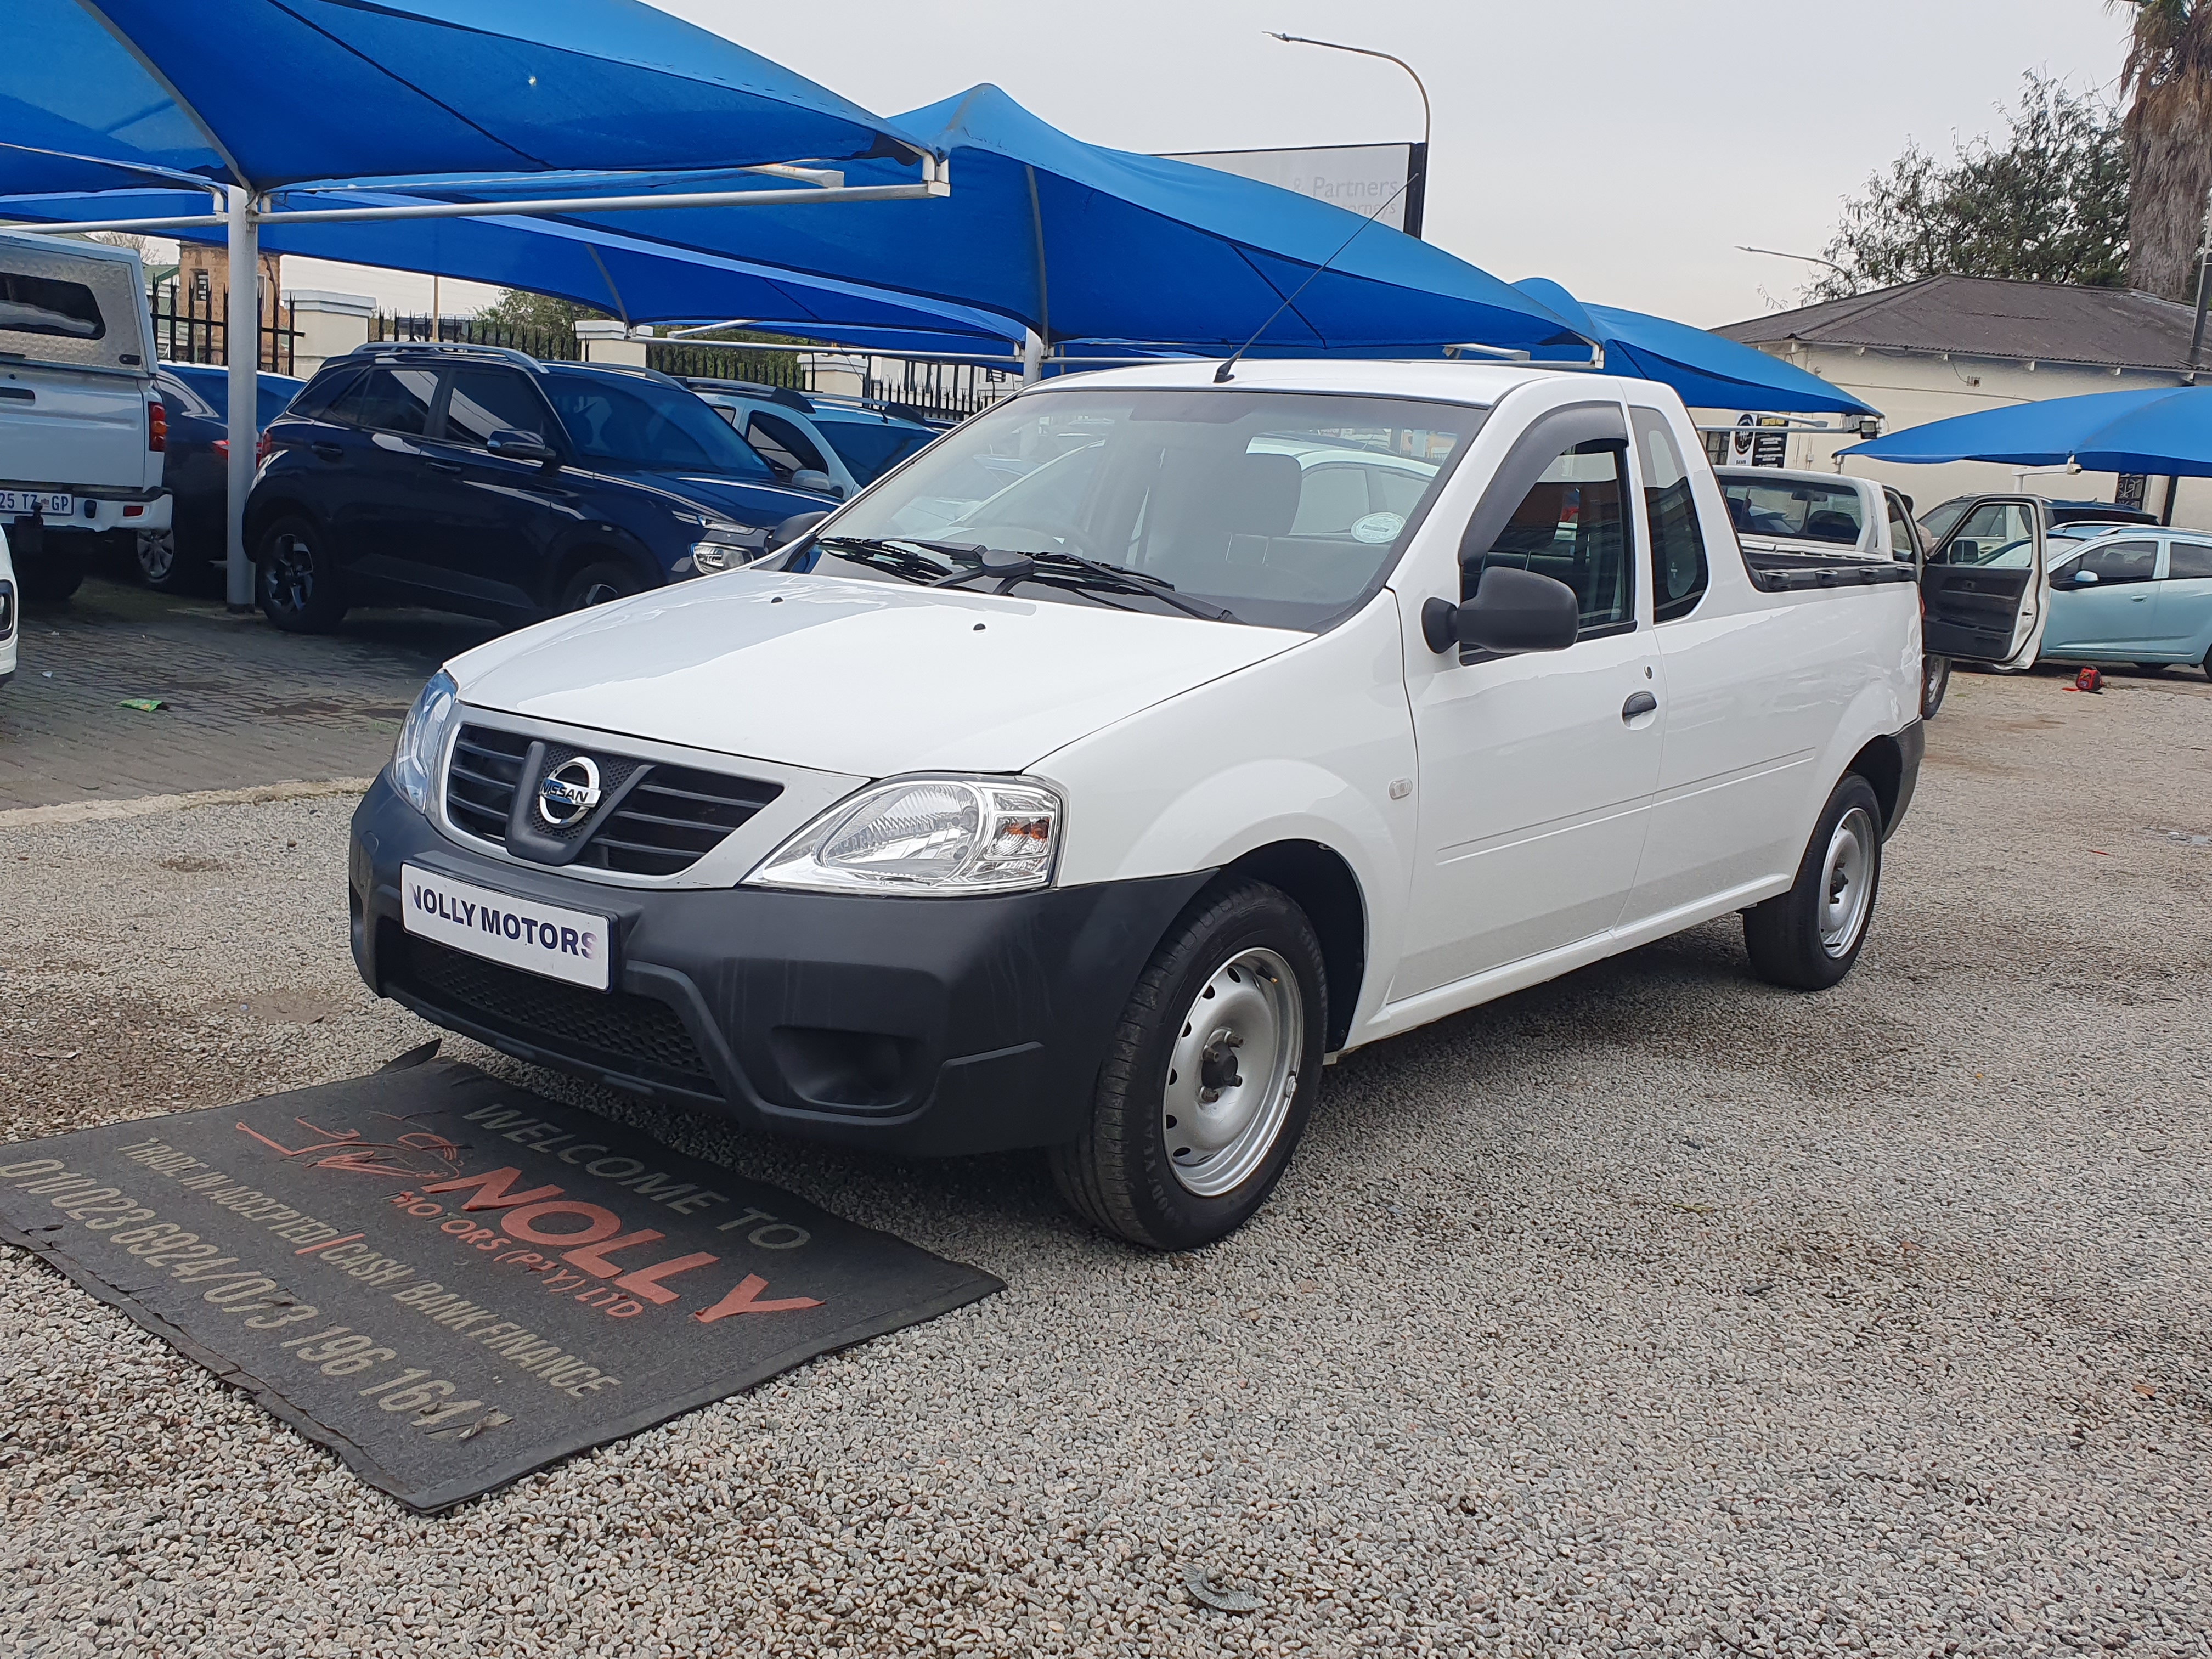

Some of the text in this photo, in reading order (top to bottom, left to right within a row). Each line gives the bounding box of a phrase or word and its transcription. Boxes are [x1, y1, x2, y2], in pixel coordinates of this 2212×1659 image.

[1312, 176, 1400, 198] Partners
[52, 495, 69, 511] GP
[540, 782, 589, 803] NISSAN
[409, 882, 598, 960] NOLLY MOTORS
[117, 1137, 210, 1177] TRADE
[178, 1171, 234, 1190] IN
[462, 1103, 812, 1250] WELCOME TO
[202, 1185, 340, 1244] ACCEPTED
[420, 1166, 827, 1324] NOLLY
[279, 1326, 397, 1376] 196
[466, 1322, 622, 1397] FINANCE
